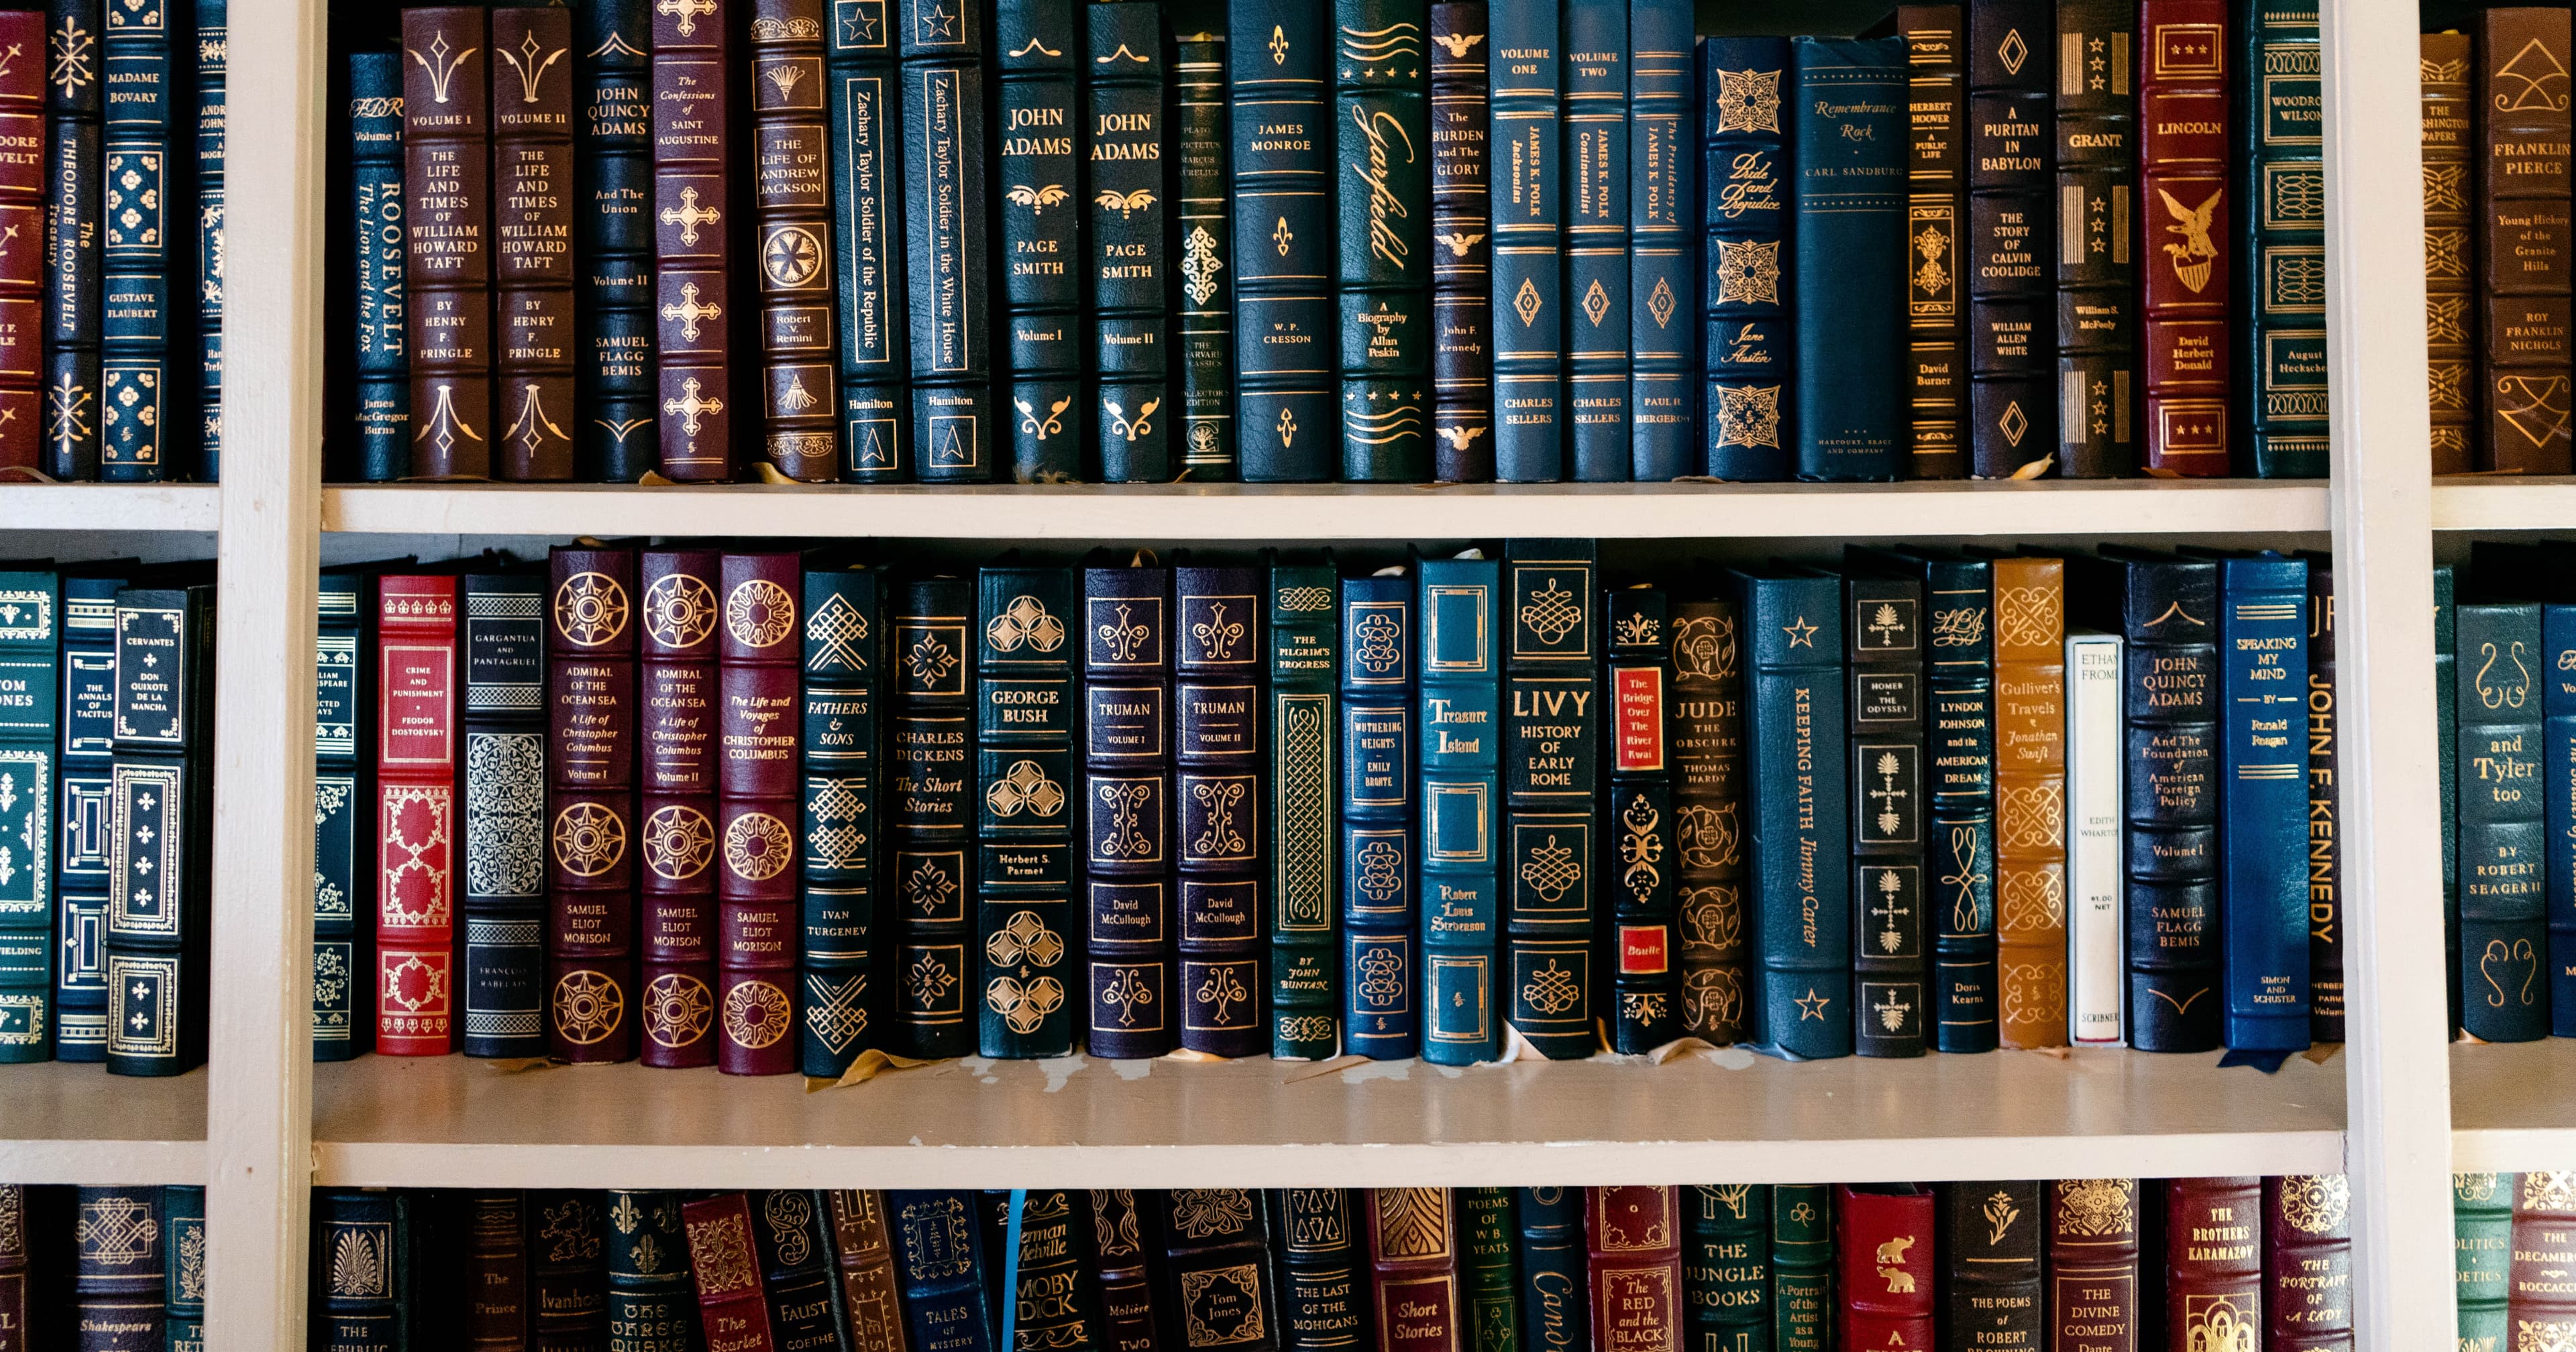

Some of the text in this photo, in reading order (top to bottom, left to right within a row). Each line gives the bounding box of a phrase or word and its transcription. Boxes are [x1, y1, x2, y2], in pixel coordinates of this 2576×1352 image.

[1501, 49, 1549, 58] VOLUME
[1512, 64, 1537, 74] ONE
[109, 73, 159, 83] MADAME
[110, 93, 157, 103] BOVARY
[596, 88, 637, 103] JOHN
[588, 104, 649, 120] QUINCY
[501, 114, 565, 123] VOLUME II
[1008, 109, 1063, 131] JOHN
[1912, 115, 1949, 123] HOOVER
[592, 123, 645, 135] ADAMS
[672, 121, 703, 129] SAINT
[1258, 125, 1303, 134] JAMES
[1984, 124, 2038, 137] PURITAN
[2157, 122, 2221, 135] LINCOLN
[355, 131, 400, 141] Volume I
[658, 135, 718, 146] AUGUSTINE
[1433, 130, 1483, 142] BURDEN
[2069, 134, 2122, 148] GRANT
[1002, 138, 1071, 156] ADAMS
[1252, 141, 1310, 152] MONROE
[2494, 143, 2570, 156] FRANKLIN
[1438, 163, 1479, 178] GLORY
[1986, 158, 2040, 171] BABYLON
[2506, 162, 2562, 174] PIERCE
[761, 166, 819, 180] ANDREW
[1529, 126, 1540, 216] JAMES K. POLK
[759, 182, 820, 194] JACKSON
[420, 197, 468, 209] TIMES
[857, 92, 877, 348] Zachary Taylor Soldier of the Republic
[62, 139, 76, 331] THEODORE ROOSEVELT
[413, 225, 478, 237] WILLIAM
[414, 241, 477, 253] HOWARD
[1018, 241, 1057, 252] PAGE
[380, 182, 402, 355] ROOSEVELT
[425, 257, 464, 268] TAFT
[1014, 262, 1063, 275] SMITH
[109, 292, 154, 302] GUSTAVE
[108, 308, 157, 318] FLAUBERT
[1358, 313, 1407, 325] Biography
[425, 317, 466, 327] HENRY
[1992, 323, 2031, 331] WILLIAM
[596, 335, 648, 347] SAMUEL
[1016, 329, 1062, 341] Volume I
[1371, 336, 1397, 345] Allan
[1996, 334, 2027, 343] ALLEN
[1997, 346, 2027, 355] WHITE
[2510, 341, 2560, 351] NICHOLS
[421, 347, 472, 359] PRINGLE
[600, 351, 644, 361] FLAGG
[603, 365, 641, 377] BEMIS
[849, 397, 893, 409] Hamilton
[127, 638, 174, 646] CERVANTES
[2237, 637, 2297, 650] SPEAKING
[1279, 648, 1330, 657] PILGRIM'S
[1279, 661, 1330, 669] PROGRESS
[567, 667, 612, 677] ADMIRAL
[2250, 668, 2286, 680] MIND
[131, 683, 168, 691] QUIXOTE
[393, 689, 444, 697] PUNISHMENT
[2000, 679, 2061, 699] Gulliver's
[137, 693, 148, 701] DE
[561, 695, 616, 705] OCEAN SEA
[991, 691, 1059, 703] GEORGE
[131, 703, 166, 711] MANCHA
[808, 702, 867, 714] FATHERS
[1514, 691, 1590, 716] LIVY
[1676, 701, 1735, 718] JUDE
[1941, 701, 1983, 712] LYNDON
[2008, 701, 2056, 717] Travels
[1003, 710, 1048, 722] BUSH
[1099, 703, 1149, 717] TRUMAN
[1428, 699, 1487, 725] Treasure
[830, 718, 843, 730] &
[1939, 719, 1984, 728] JOHNSON
[392, 728, 444, 736] DOSTOEVSKY
[563, 728, 617, 740] Christopher
[897, 732, 963, 744] CHARLES
[1521, 726, 1581, 738] HISTORY
[820, 733, 853, 744] SONS
[1438, 730, 1479, 754] Island
[1627, 736, 1652, 745] River
[2491, 735, 2522, 753] and
[567, 742, 612, 752] Columbus
[1541, 742, 1560, 753] OF
[898, 750, 964, 761] DICKENS
[1937, 754, 1990, 767] AMERICAN
[1529, 757, 1574, 769] EARLY
[2474, 757, 2535, 783] Tyler
[1531, 773, 1571, 785] ROME
[1945, 773, 1982, 784] DREAM
[924, 778, 962, 792] Short
[2493, 787, 2521, 802] too
[905, 797, 953, 812] Stories
[2310, 675, 2333, 943] JOHN F. KENNEDY
[1796, 688, 1819, 947] KEEPING FAITH Jimmy Carter
[2477, 862, 2534, 876] ROBERT
[567, 905, 607, 914] SAMUEL
[1114, 900, 1138, 910] David
[823, 911, 849, 919] IVAN
[1102, 913, 1150, 927] McCullough
[573, 919, 601, 929] ELIOT
[807, 926, 866, 936] TURGENEV
[564, 933, 610, 943] MORISON
[2261, 976, 2290, 984] SIMON
[2253, 995, 2296, 1003] SCHUSTER
[2193, 1224, 2249, 1243] BROTHERS
[2189, 1243, 2253, 1261] KARAMAZOV
[2280, 1275, 2348, 1290] PORTRAIT
[1295, 1284, 1350, 1298] THE LAST
[1210, 1294, 1236, 1304] Tom
[1623, 1297, 1655, 1310] RED
[780, 1300, 828, 1321] FAUST
[926, 1307, 967, 1321] TALES
[1017, 1295, 1079, 1321] DICK
[1210, 1304, 1240, 1320] Jones
[1399, 1301, 1438, 1317] Short
[2072, 1306, 2120, 1318] DIVINE
[80, 1320, 151, 1334] Shakespeare
[1294, 1316, 1357, 1331] MOHICANS
[2065, 1323, 2126, 1336] COMEDY
[1395, 1322, 1442, 1339] Stories
[1978, 1331, 2027, 1343] ROBERT
